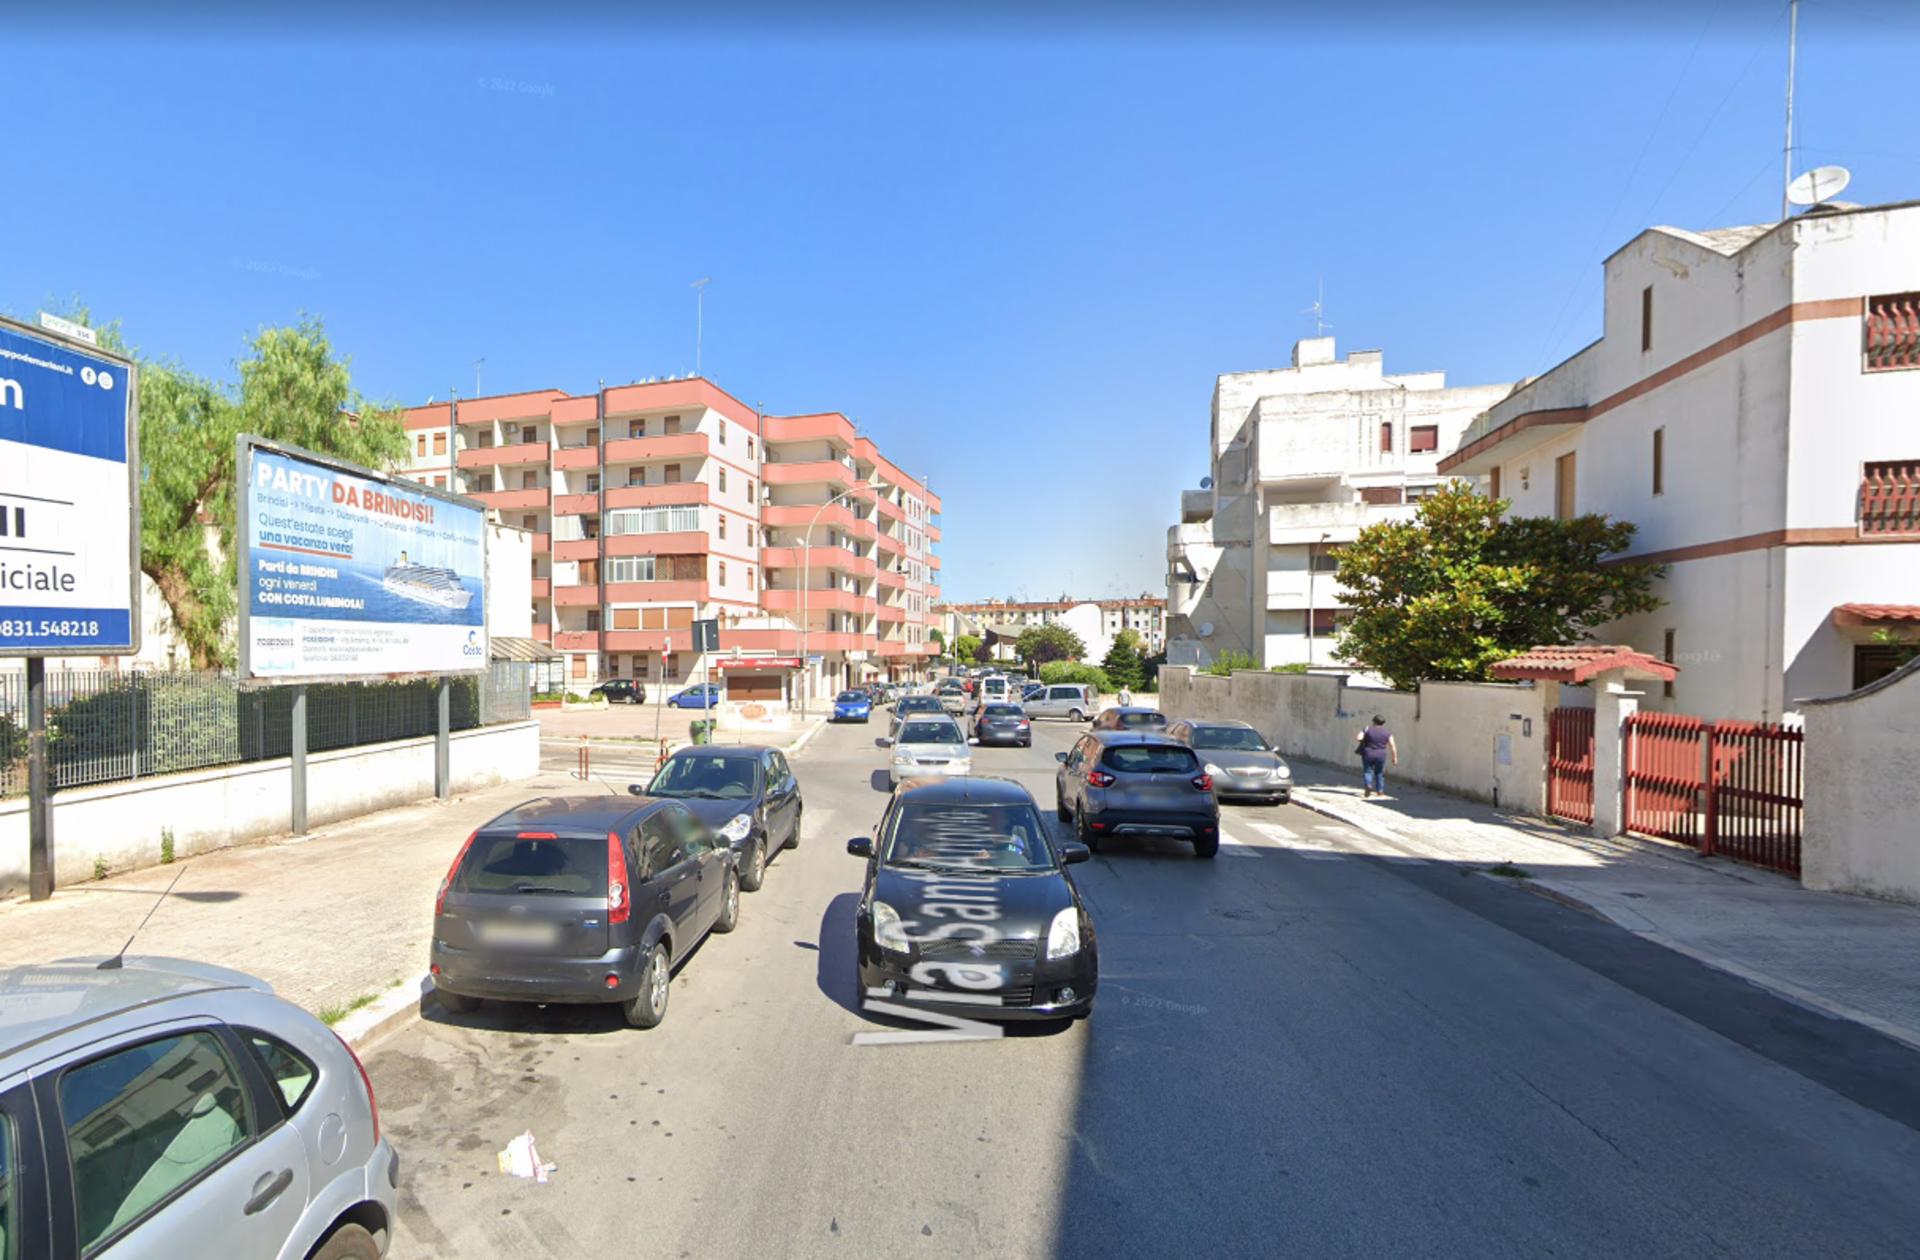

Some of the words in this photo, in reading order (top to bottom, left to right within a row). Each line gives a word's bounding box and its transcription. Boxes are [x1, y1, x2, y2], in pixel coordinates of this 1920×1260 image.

[257, 462, 329, 500] PARTY
[332, 481, 360, 508] DA
[363, 489, 434, 525] BRINDISI!
[259, 512, 325, 535] Quest'estate
[260, 530, 282, 543] una
[284, 533, 328, 550] vacanza
[1, 562, 75, 592] iciale
[259, 559, 285, 574] Parti
[286, 563, 299, 575] da
[259, 576, 281, 591] ogni
[259, 591, 282, 605] CON
[284, 593, 316, 607] COSTA
